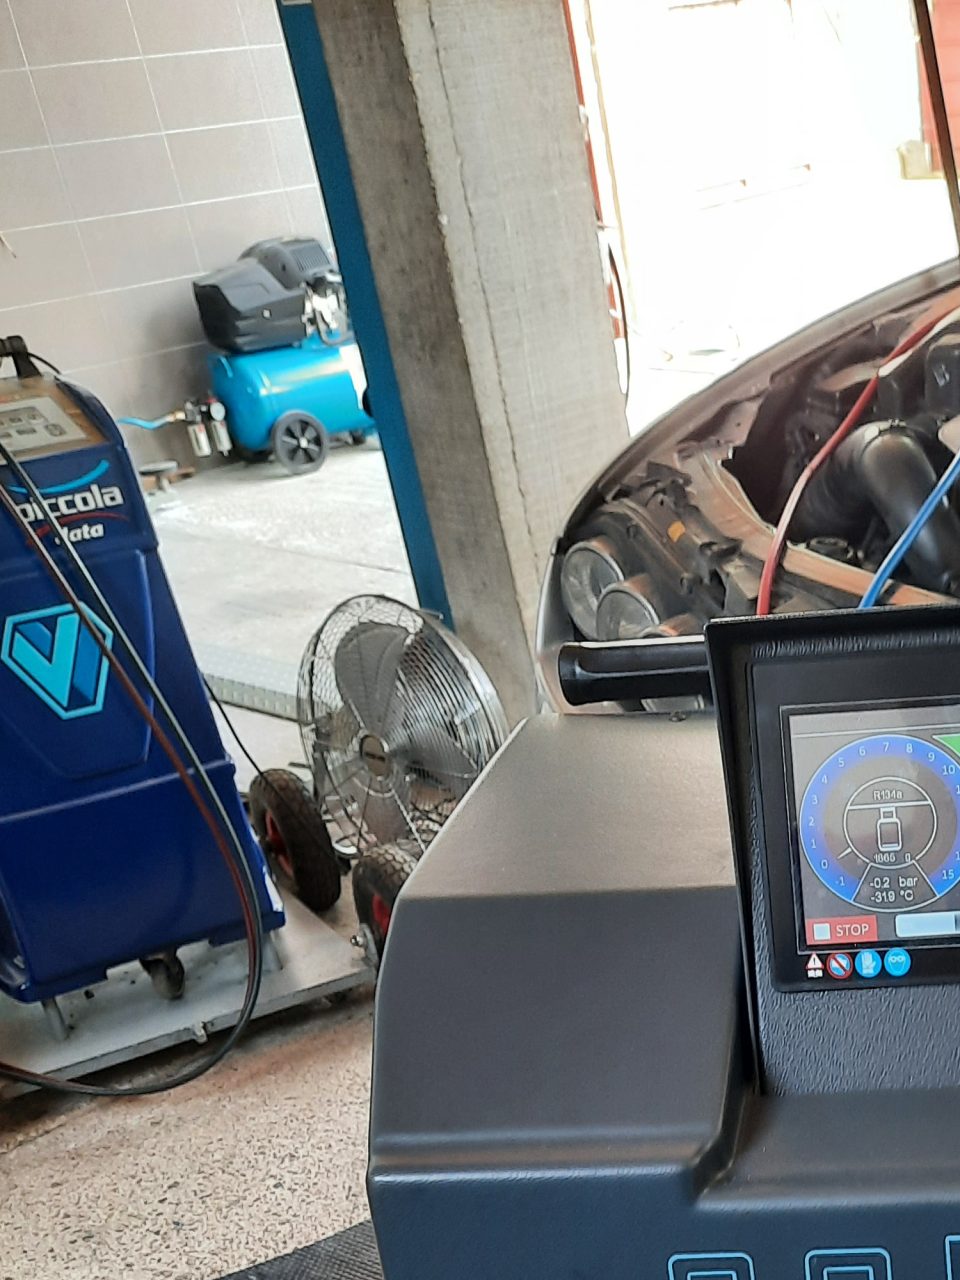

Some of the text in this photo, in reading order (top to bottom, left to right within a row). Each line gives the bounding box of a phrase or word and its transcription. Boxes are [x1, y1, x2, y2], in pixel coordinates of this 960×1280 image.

[858, 746, 866, 757] 6
[882, 742, 890, 752] 7
[905, 743, 914, 754] 8
[838, 757, 846, 768] 5
[927, 752, 936, 763] 9
[942, 765, 956, 776] 10
[821, 774, 829, 784] 4
[811, 794, 819, 805] 3
[808, 816, 816, 827] 2
[820, 859, 829, 870] 0
[942, 868, 955, 880] 15
[834, 875, 845, 886] -1
[870, 876, 918, 889] -0.2 bar
[834, 923, 870, 937] STOP
